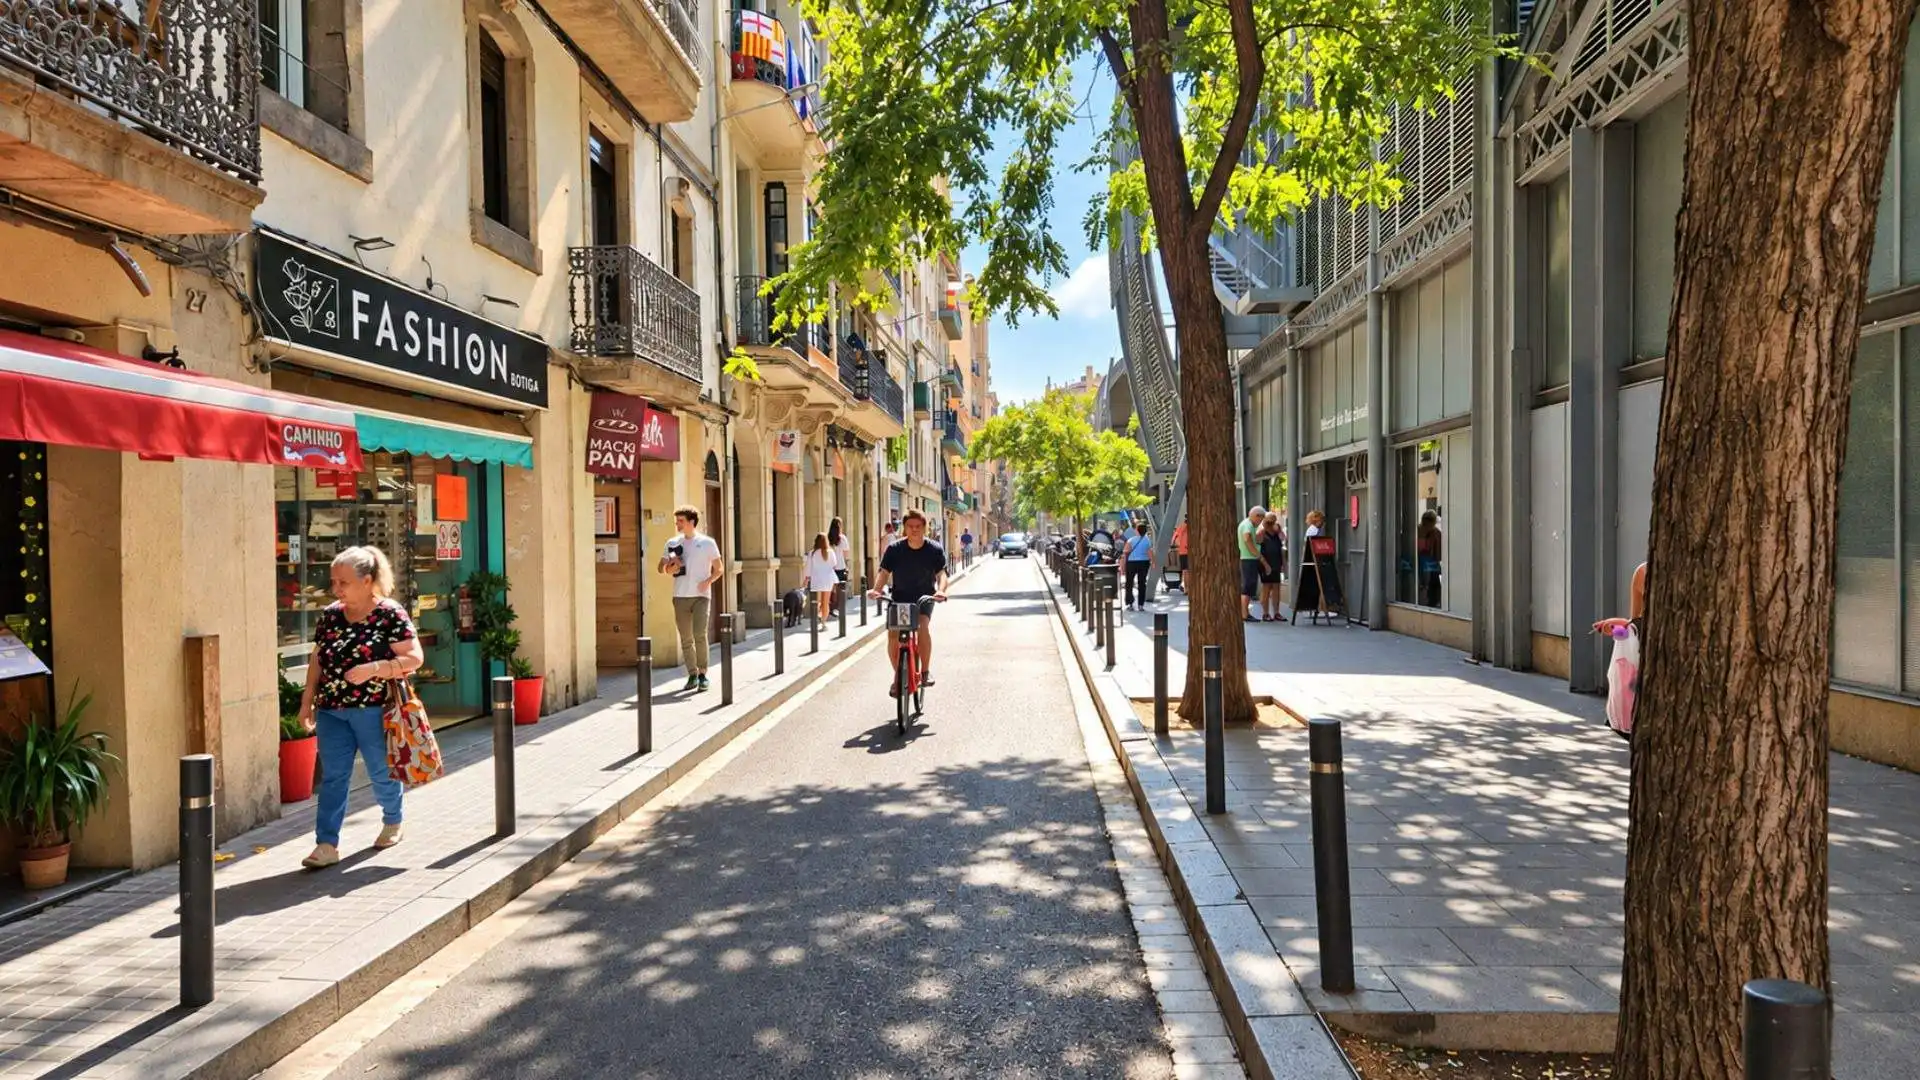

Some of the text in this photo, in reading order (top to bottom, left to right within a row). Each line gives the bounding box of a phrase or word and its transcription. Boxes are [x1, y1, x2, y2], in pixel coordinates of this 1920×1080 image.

[186, 288, 207, 313] 27
[351, 289, 540, 393] FASHION BOTIGA
[283, 424, 343, 449] CAMINHO
[588, 450, 636, 470] PAN
